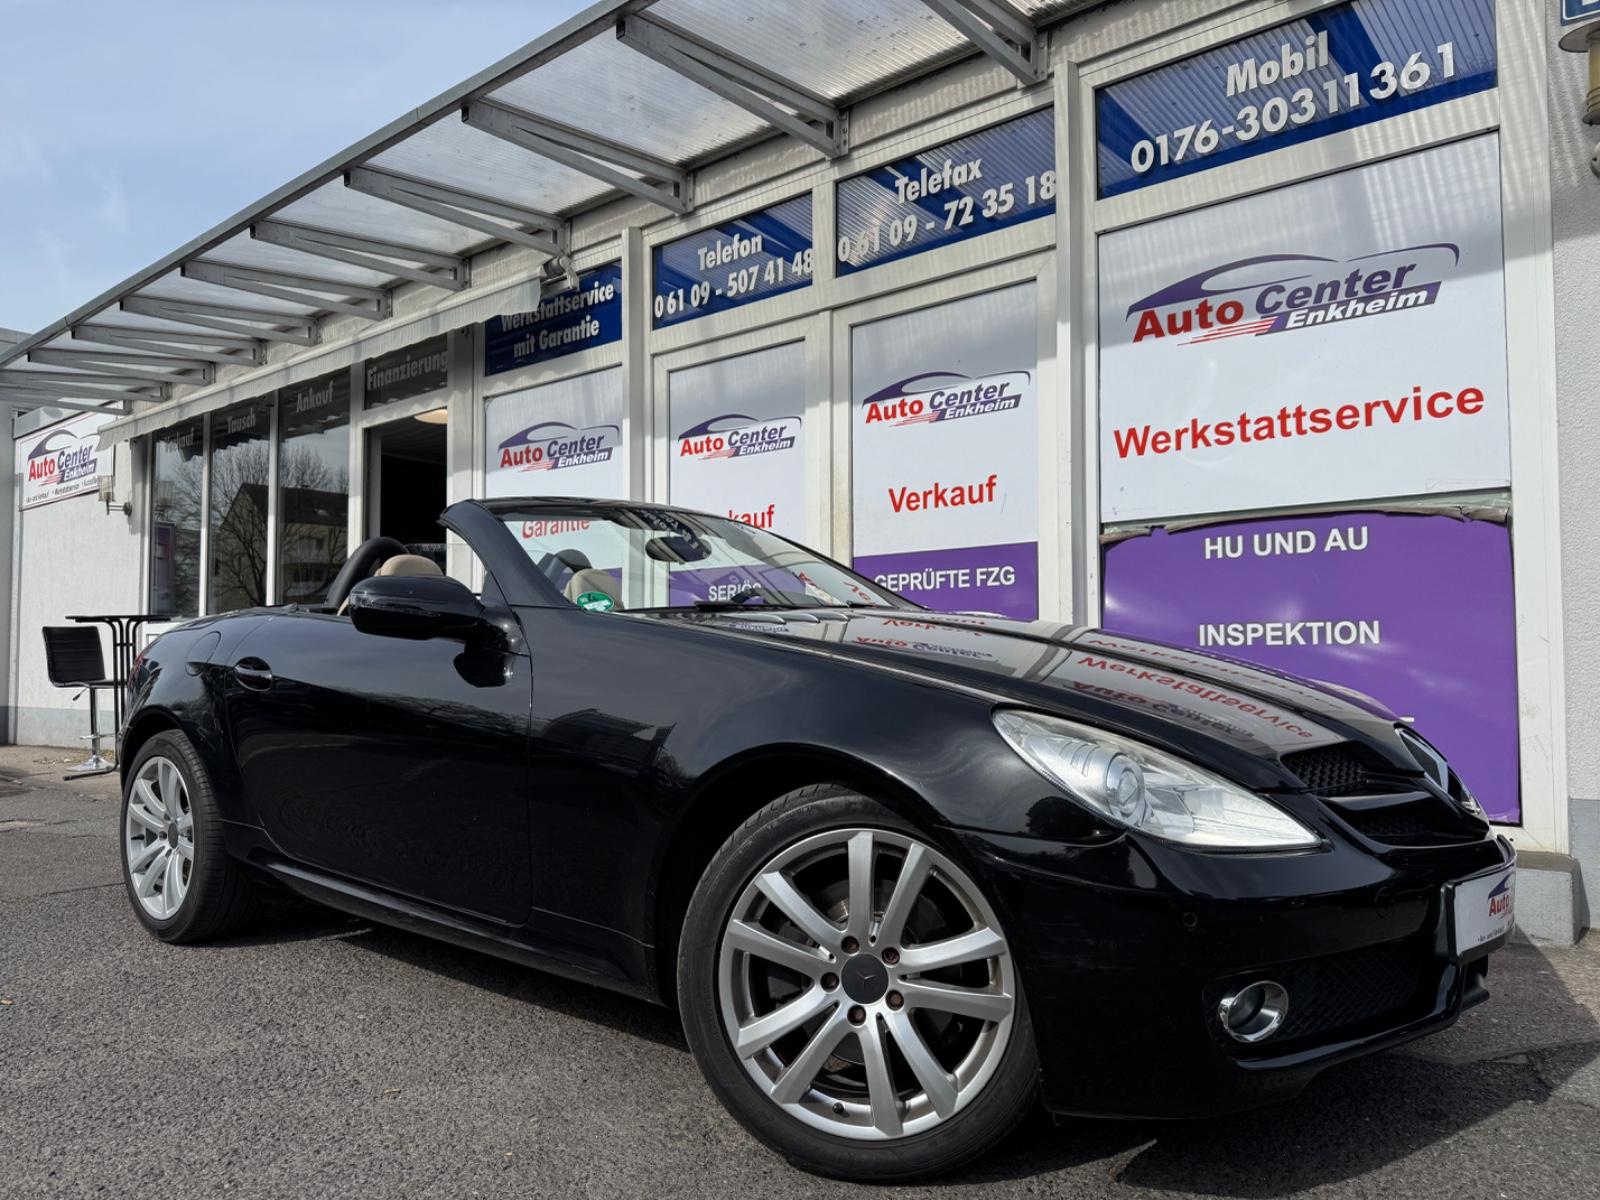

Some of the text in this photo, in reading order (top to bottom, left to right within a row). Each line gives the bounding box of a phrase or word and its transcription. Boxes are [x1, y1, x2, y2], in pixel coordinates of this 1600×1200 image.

[1226, 31, 1328, 97] Mobil
[895, 158, 982, 205] Telefax
[890, 214, 917, 246] 09
[944, 196, 974, 231] 72
[982, 182, 1014, 218] 35
[1026, 170, 1056, 205] 18
[698, 233, 762, 271] Telefon
[691, 281, 710, 308] 09
[727, 265, 759, 297] 507
[764, 258, 784, 285] 41
[792, 248, 813, 276] 48
[501, 281, 614, 332] Werkstattservice
[1132, 263, 1416, 343] Auto Center
[1284, 284, 1428, 330] Enkheim
[514, 315, 600, 358] mit Garantie
[366, 350, 448, 390] Finanzierung
[296, 381, 334, 413] Ankauf
[865, 380, 1010, 424] Auto Center
[944, 397, 1016, 420] Enkheim
[1114, 385, 1484, 458] Werkstattservice
[500, 435, 604, 468] Auto Center
[558, 451, 608, 468] Enkheim
[680, 426, 787, 456] Auto Center
[738, 438, 792, 456] Enkheim
[28, 445, 93, 481] Auto Center
[888, 474, 997, 513] Verkauf
[1204, 526, 1368, 559] HU UND AU
[875, 566, 1015, 592] GEPRÜFTE FZG
[1199, 620, 1380, 647] INSPEKTION
[1489, 894, 1510, 916] Auto
